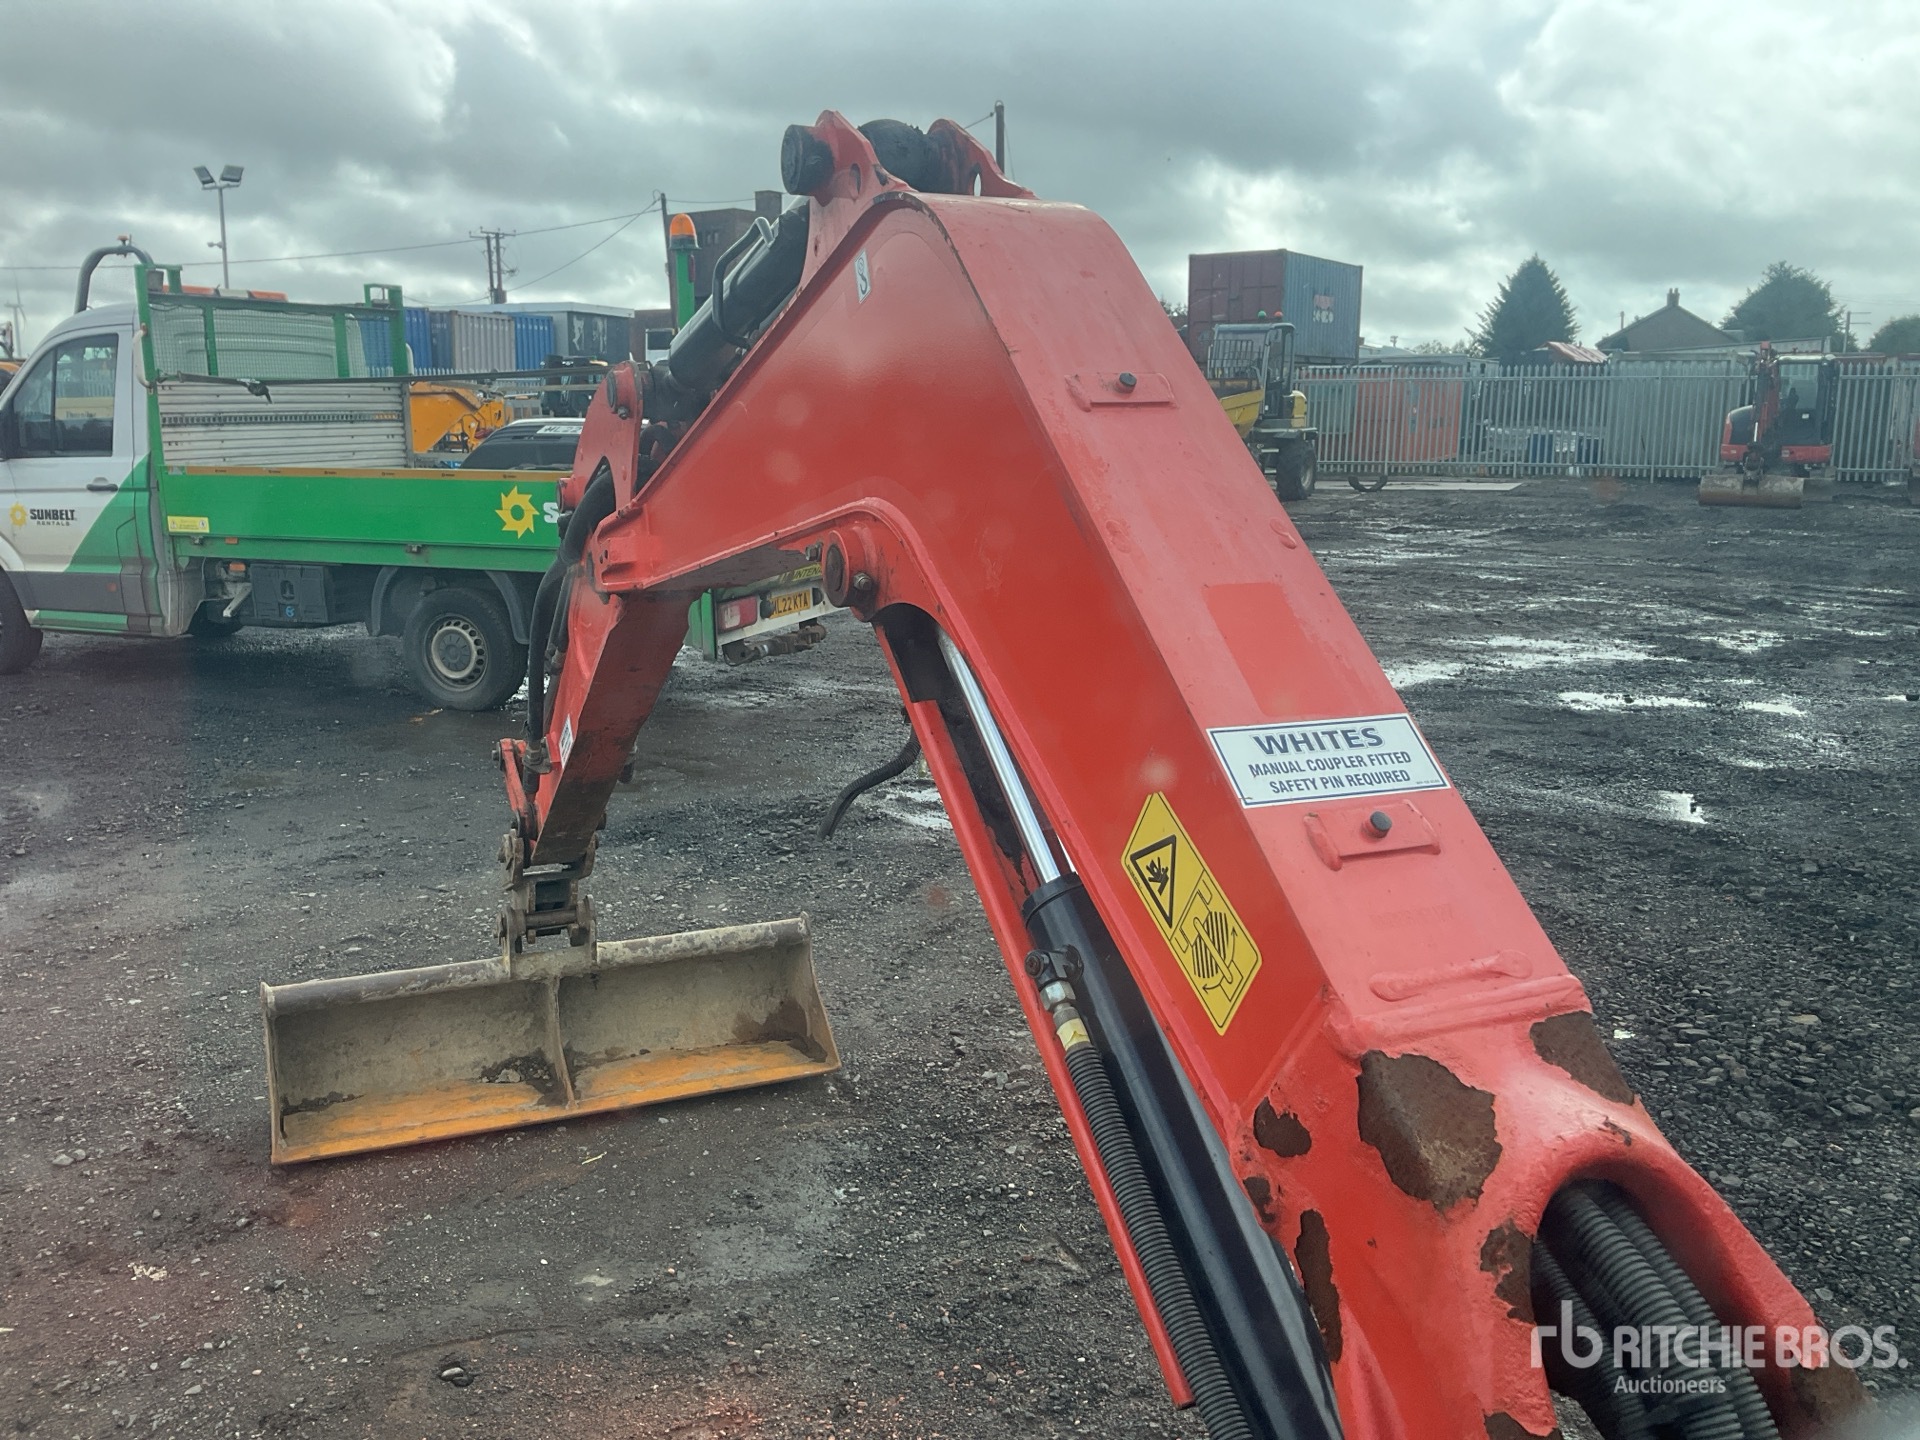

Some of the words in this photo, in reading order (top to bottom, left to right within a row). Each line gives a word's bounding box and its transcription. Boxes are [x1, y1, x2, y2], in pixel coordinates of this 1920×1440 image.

[30, 509, 75, 520] SUNBELT
[1251, 727, 1384, 755] WHITES
[1248, 760, 1306, 778] MANUAL
[1306, 755, 1366, 772] COUPLER
[1366, 751, 1412, 766] FITTED
[1269, 777, 1318, 794] SAFETY
[1320, 774, 1345, 789] PIN
[1344, 769, 1411, 787] REQUIRED
